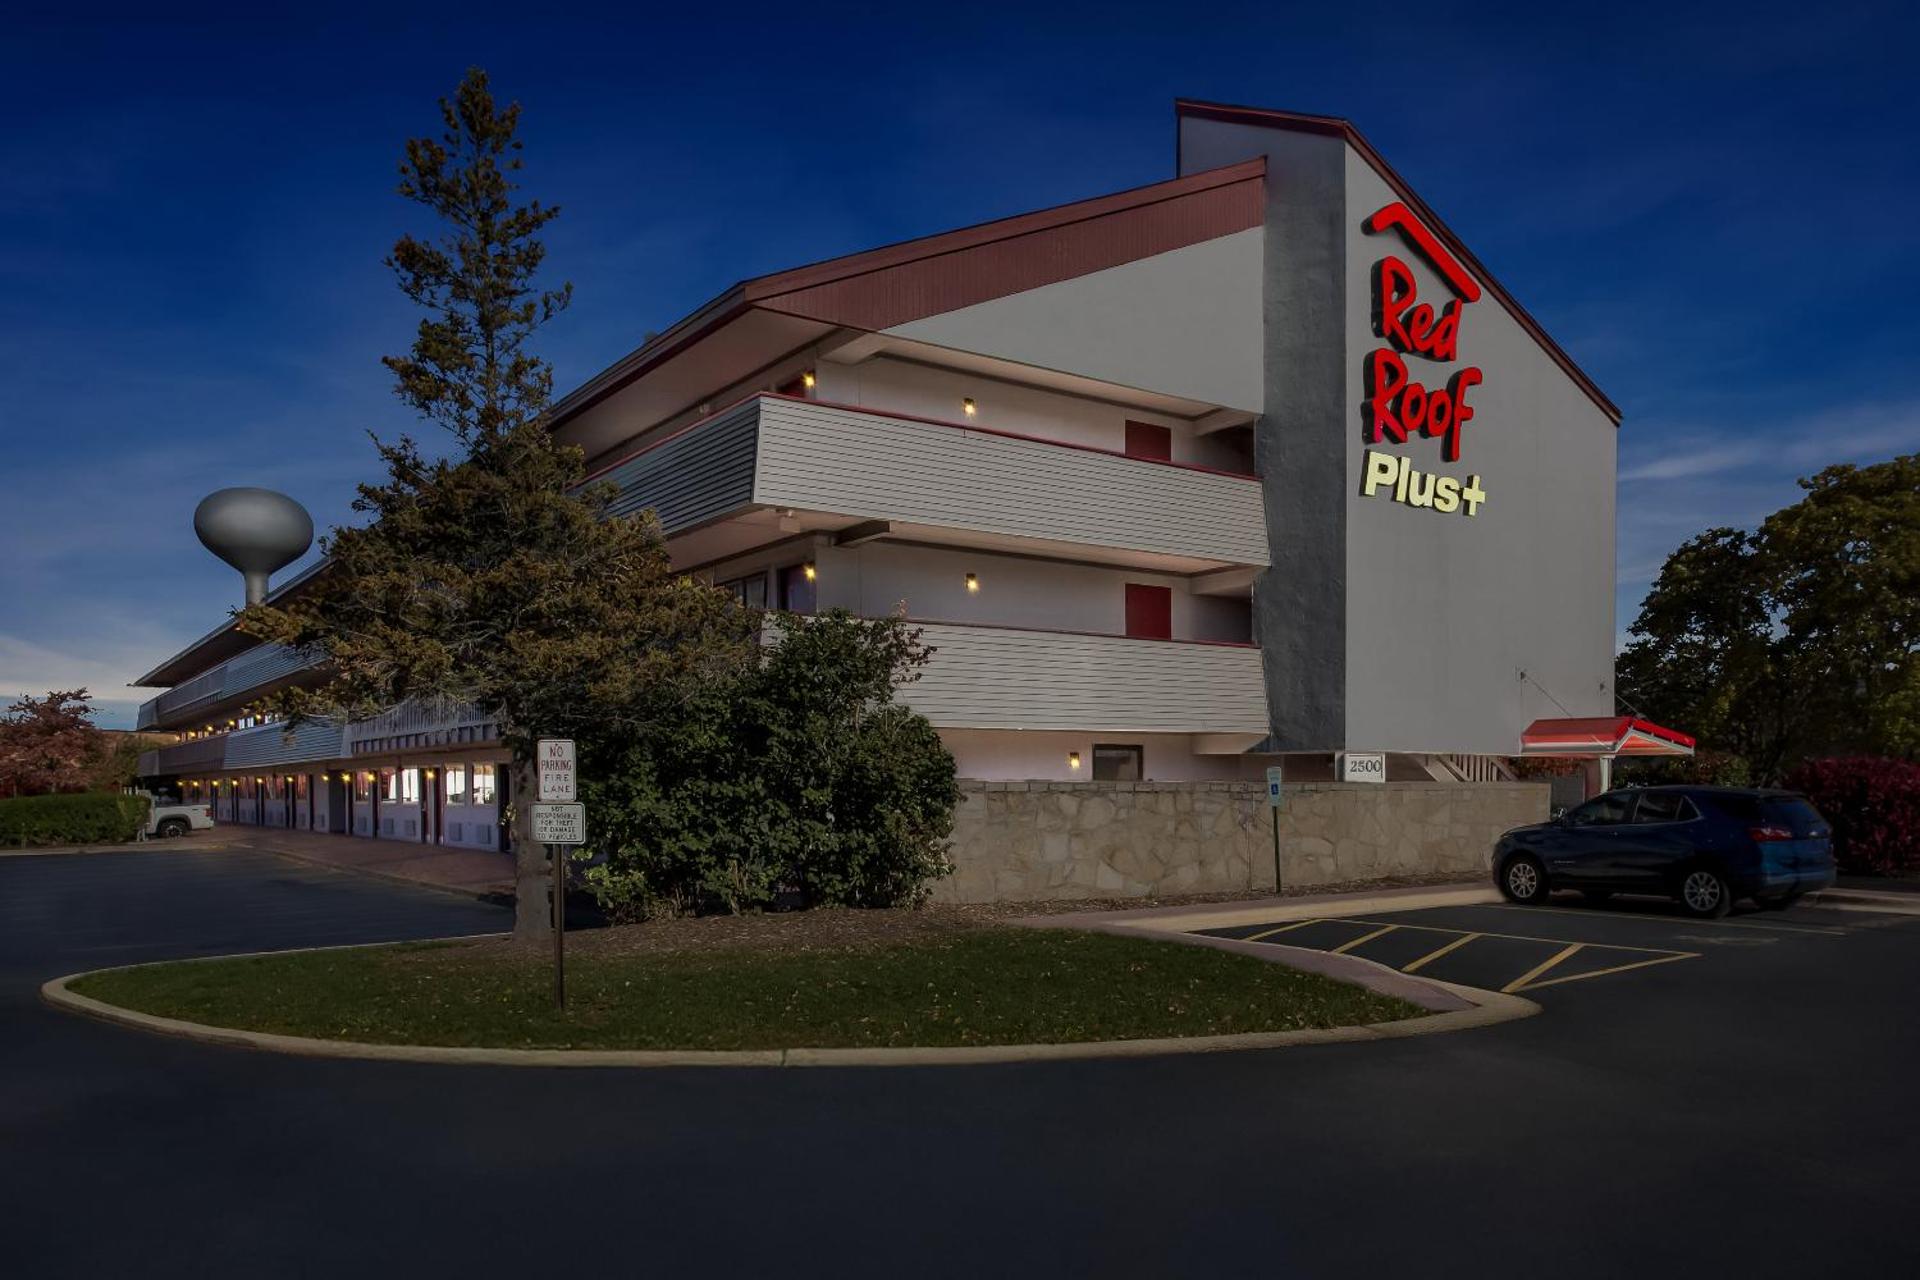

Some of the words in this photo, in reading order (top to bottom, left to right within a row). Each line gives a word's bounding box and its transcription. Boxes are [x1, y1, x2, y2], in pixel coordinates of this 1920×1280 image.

[1371, 255, 1463, 361] Red
[1361, 347, 1483, 462] Roof
[549, 746, 564, 758] NO
[540, 759, 572, 771] PARKING
[1350, 759, 1382, 773] 2500
[544, 773, 569, 782] FIRE
[543, 785, 572, 793] LANE
